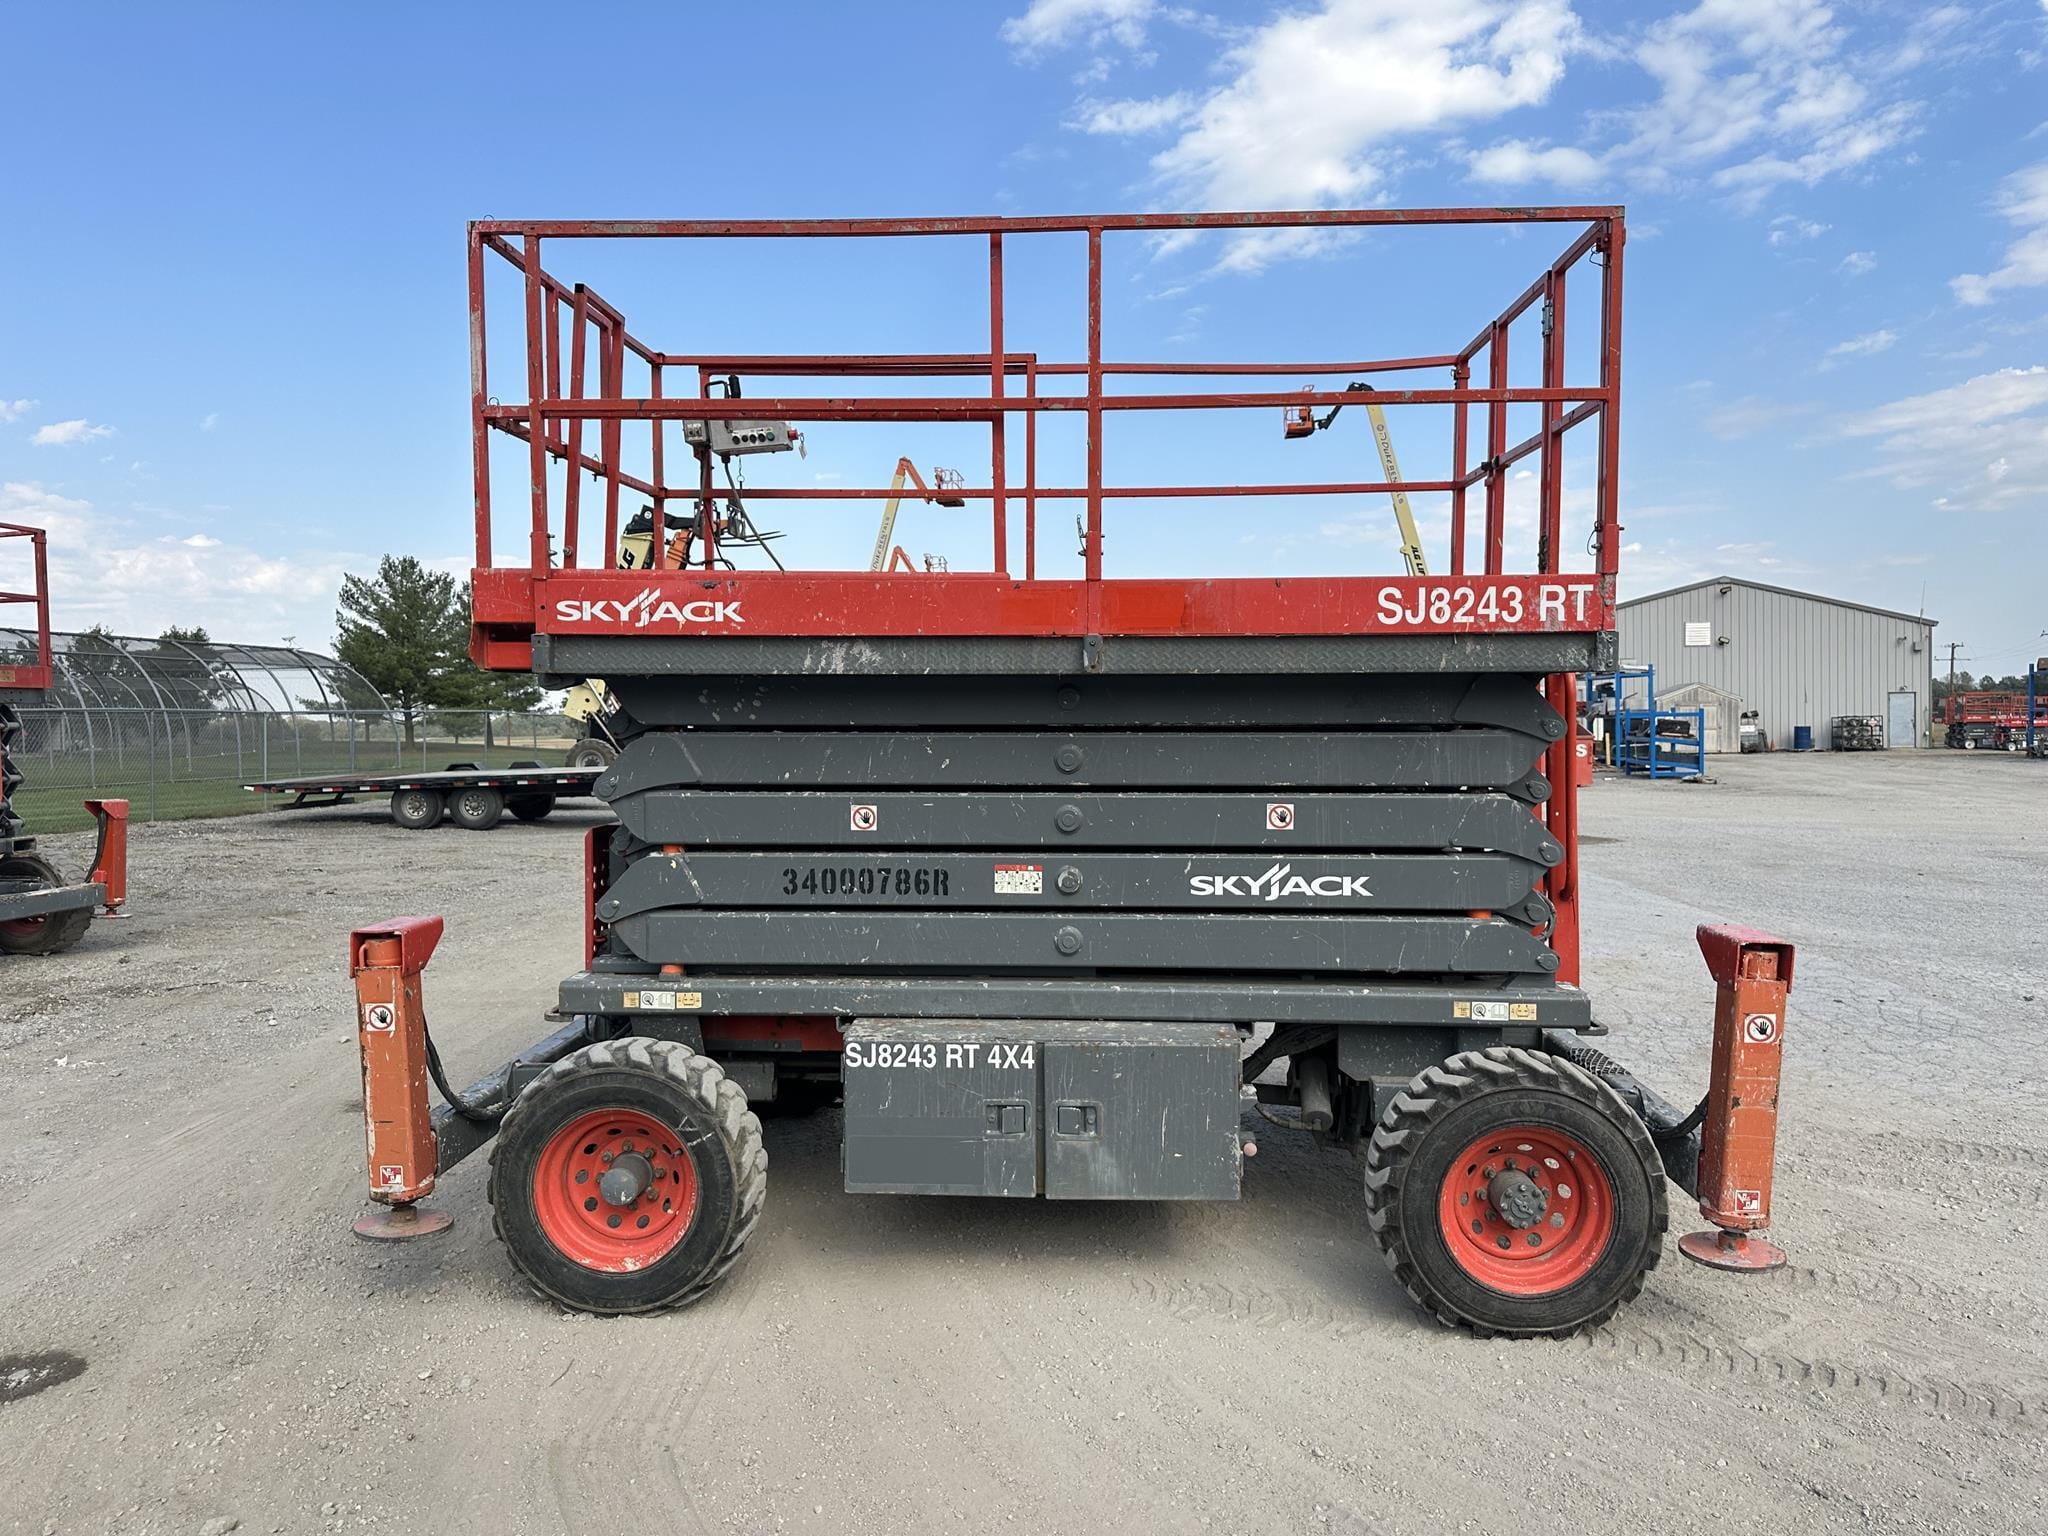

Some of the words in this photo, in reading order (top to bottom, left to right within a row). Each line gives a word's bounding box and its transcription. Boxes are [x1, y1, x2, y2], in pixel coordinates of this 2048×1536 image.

[556, 587, 745, 627] SKYJACK
[1377, 586, 1523, 625] SJ8243
[1539, 584, 1594, 622] RT
[782, 867, 949, 896] 34000786R
[1189, 862, 1374, 901] SKYJACK
[845, 1043, 937, 1069] SJ8243
[946, 1043, 980, 1069] RT
[987, 1044, 1036, 1069] 4X4
